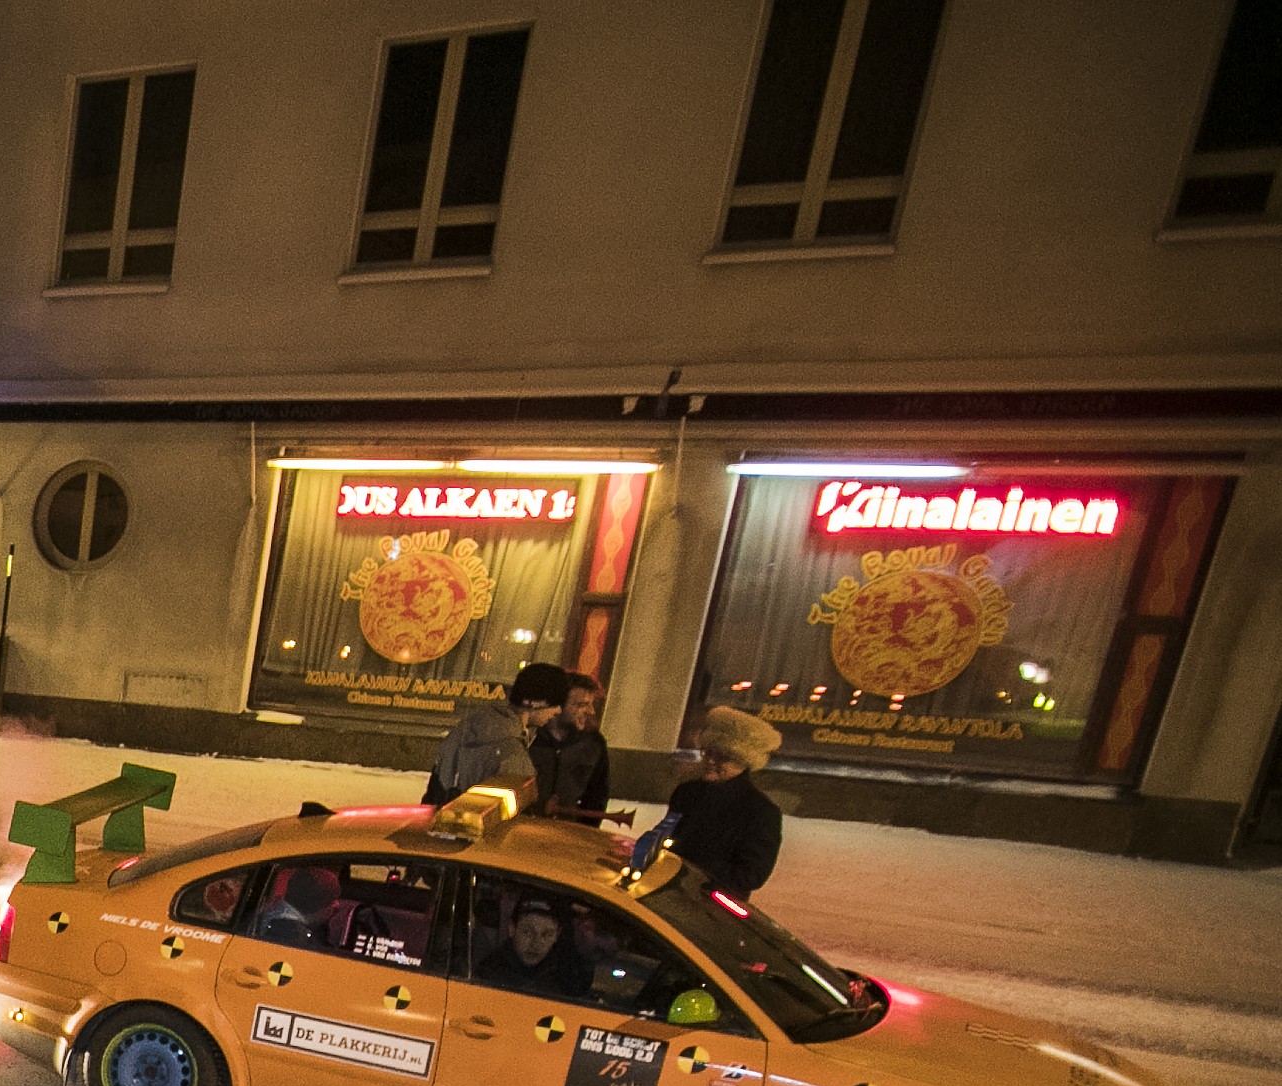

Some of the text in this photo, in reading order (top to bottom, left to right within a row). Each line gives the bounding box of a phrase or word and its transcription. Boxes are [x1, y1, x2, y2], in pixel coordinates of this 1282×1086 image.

[398, 487, 548, 519] ALKAEN
[99, 912, 227, 945] NIELS DE VROOME
[295, 1026, 315, 1042] DE
